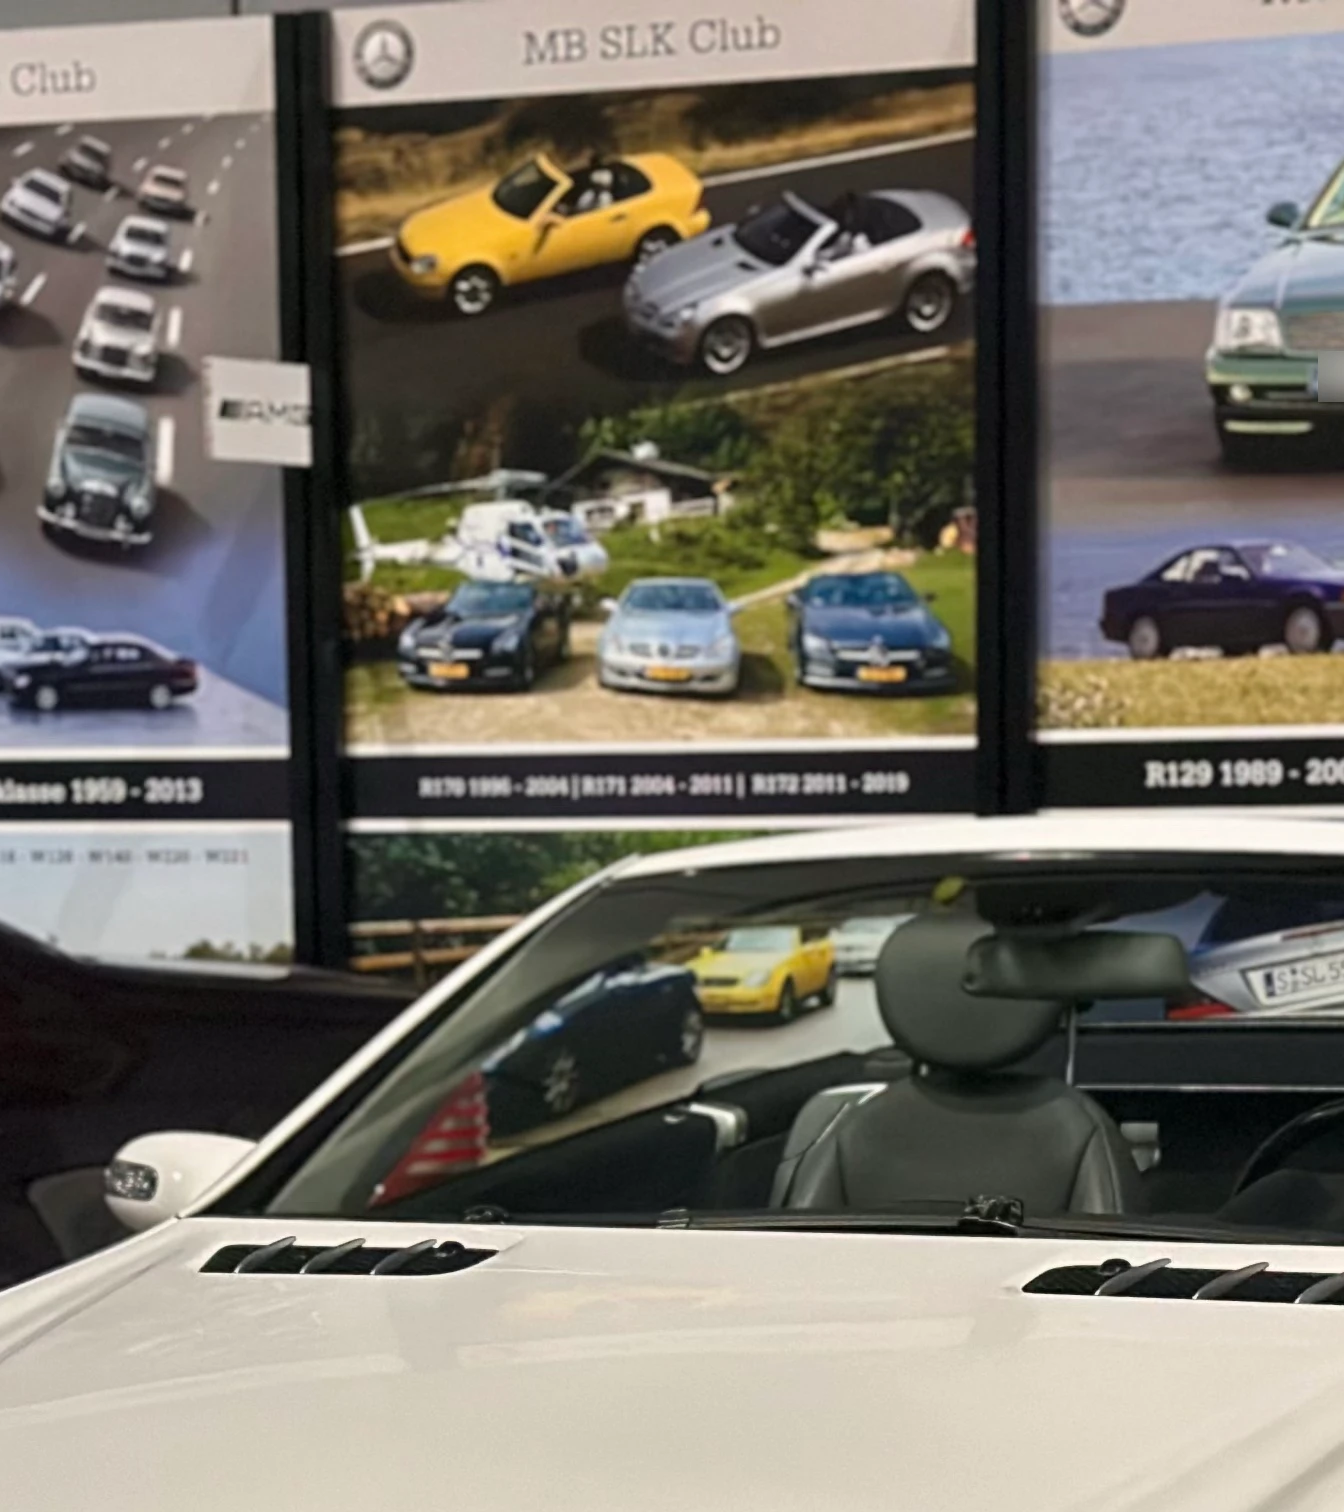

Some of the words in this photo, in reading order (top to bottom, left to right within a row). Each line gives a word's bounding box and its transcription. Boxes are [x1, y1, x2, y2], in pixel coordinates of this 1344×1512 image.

[523, 27, 588, 67] MB
[600, 23, 676, 62] SLK
[689, 16, 781, 53] Club
[10, 59, 96, 98] Club
[70, 777, 126, 804] 1959
[144, 776, 203, 802] 2013
[1144, 761, 1212, 788] R129
[1219, 760, 1283, 787] 1989
